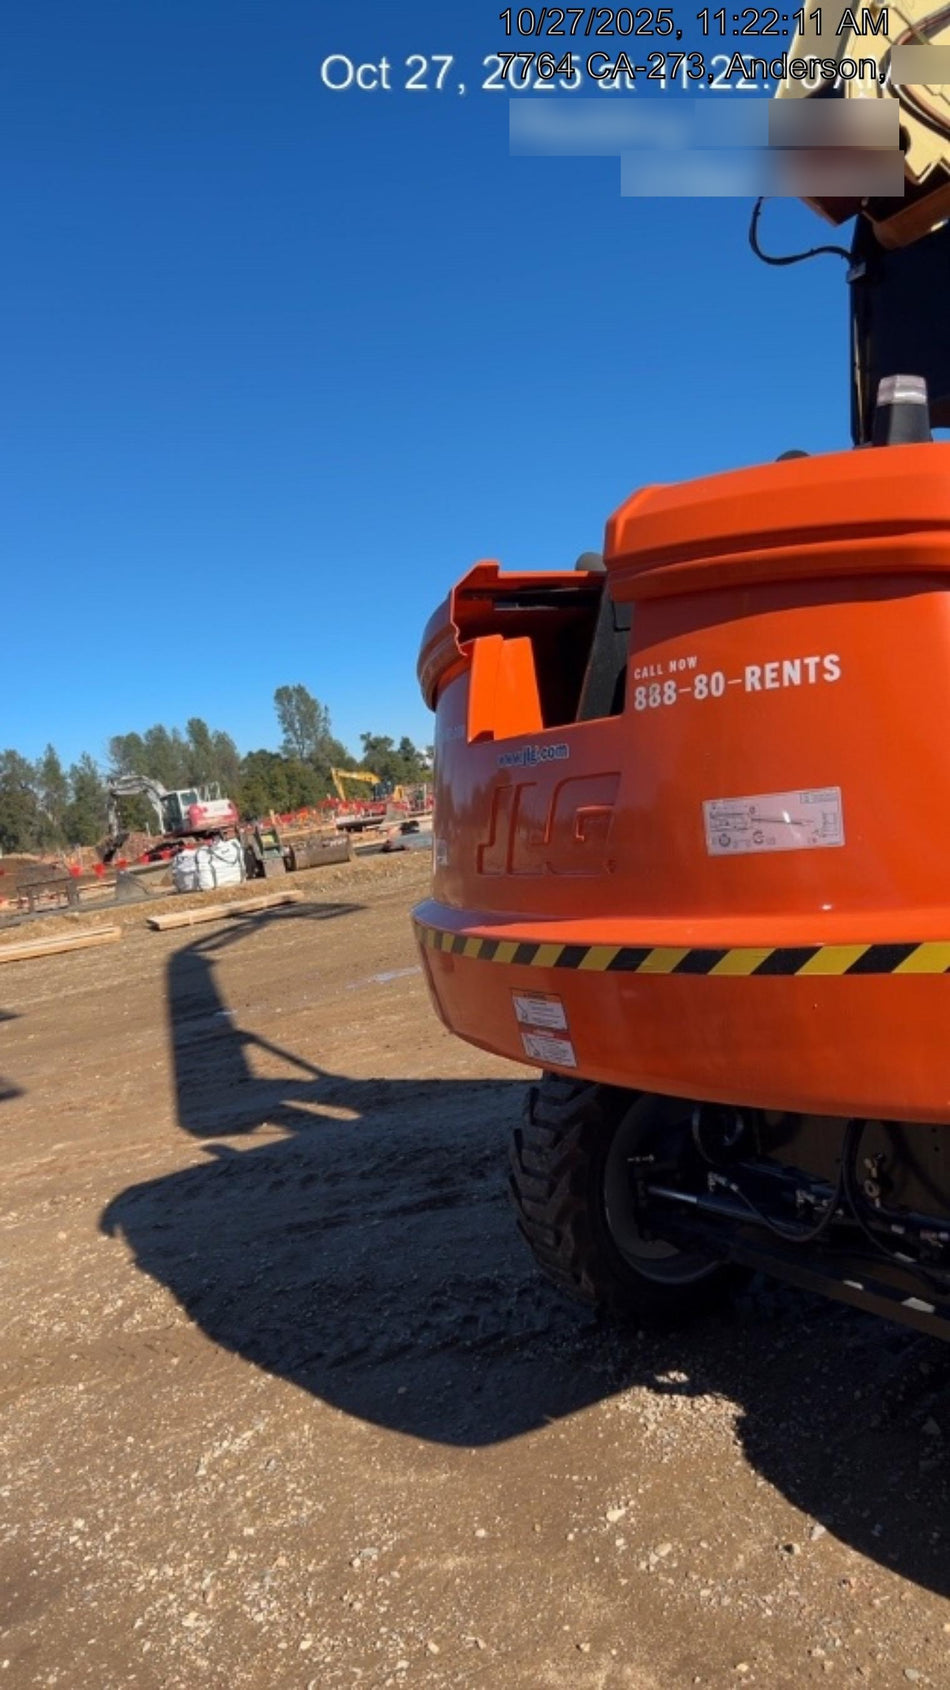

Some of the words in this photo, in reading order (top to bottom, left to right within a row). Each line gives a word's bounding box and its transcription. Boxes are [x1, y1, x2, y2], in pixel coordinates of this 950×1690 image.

[634, 666, 663, 680] CALL
[669, 656, 698, 673] NOW
[634, 654, 842, 711] 888-80-RENTS
